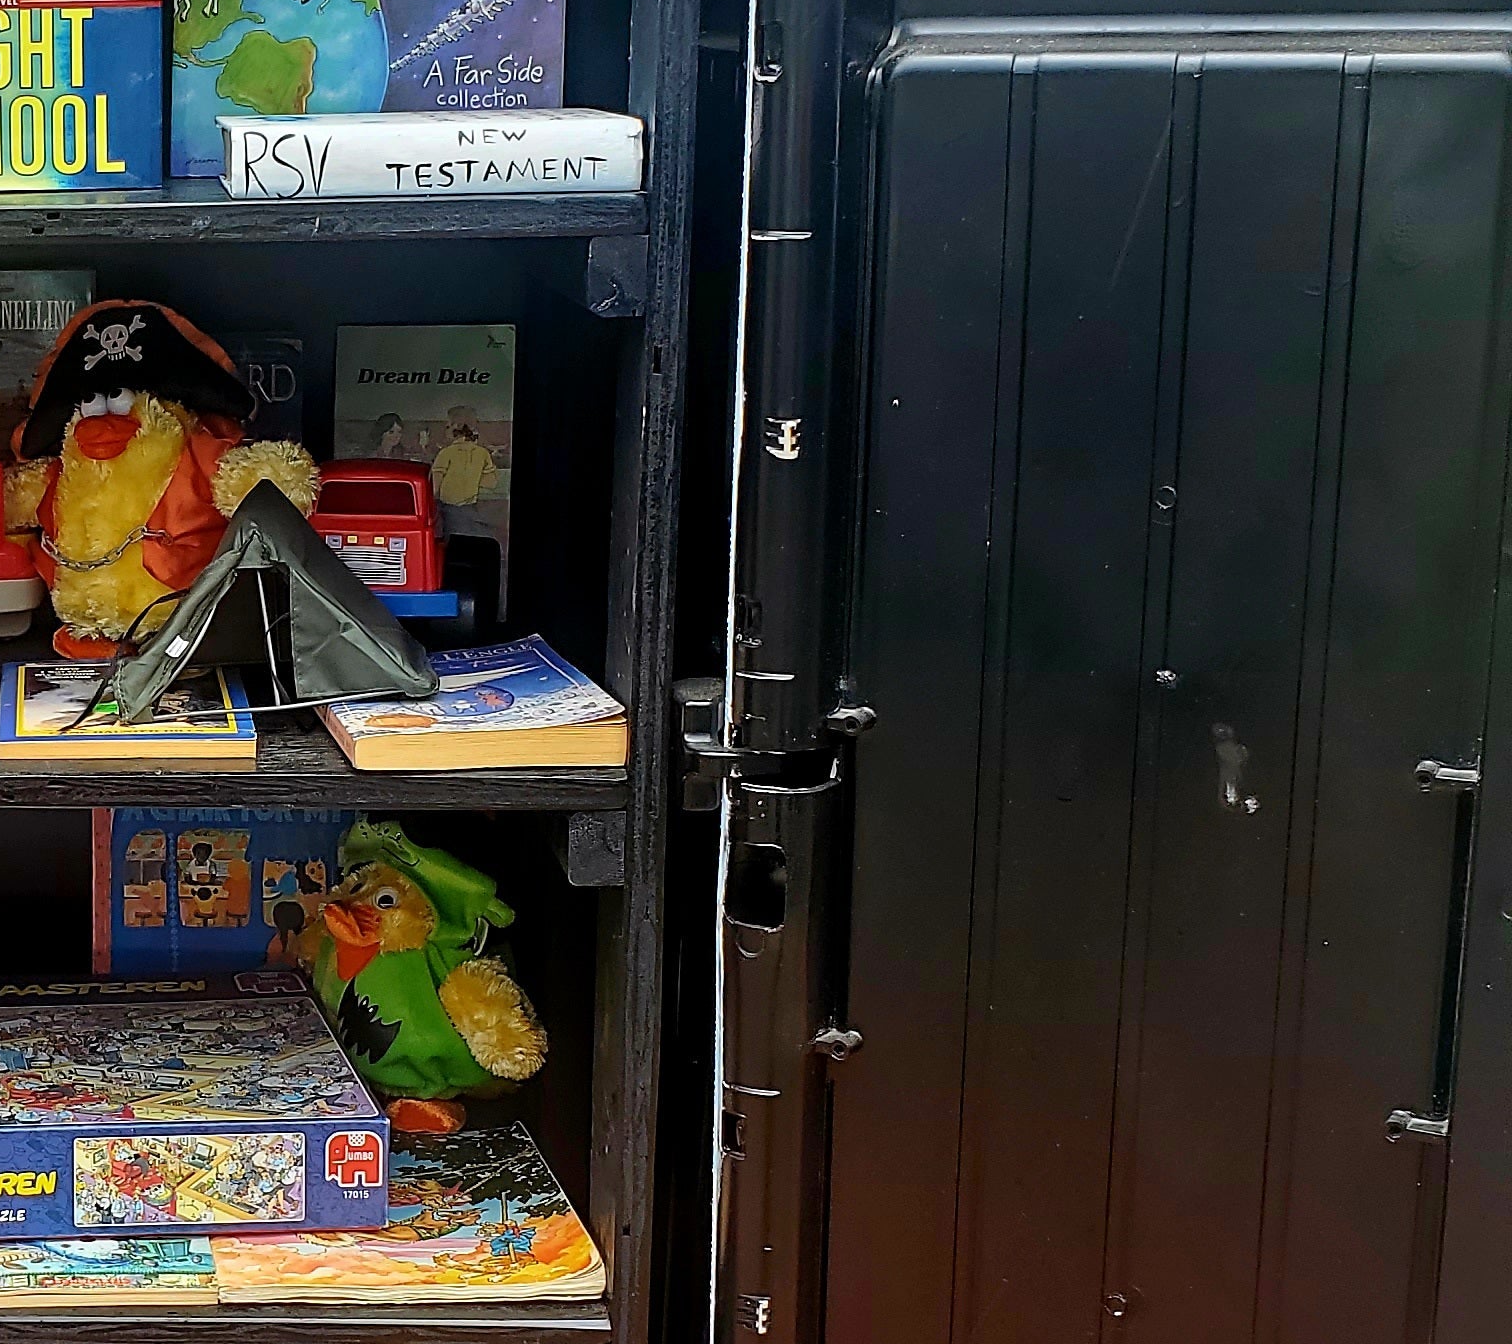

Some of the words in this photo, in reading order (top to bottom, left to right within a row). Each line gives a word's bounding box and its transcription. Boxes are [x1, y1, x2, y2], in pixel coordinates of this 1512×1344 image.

[423, 67, 444, 89] A
[454, 55, 493, 86] Far
[498, 55, 544, 84] Side
[436, 87, 529, 109] collection
[458, 128, 527, 146] NEW
[243, 132, 334, 199] RSV
[386, 157, 608, 190] TESTAMENT
[357, 368, 432, 385] Dream
[437, 368, 491, 385] Date
[343, 1190, 370, 1199] 17015
